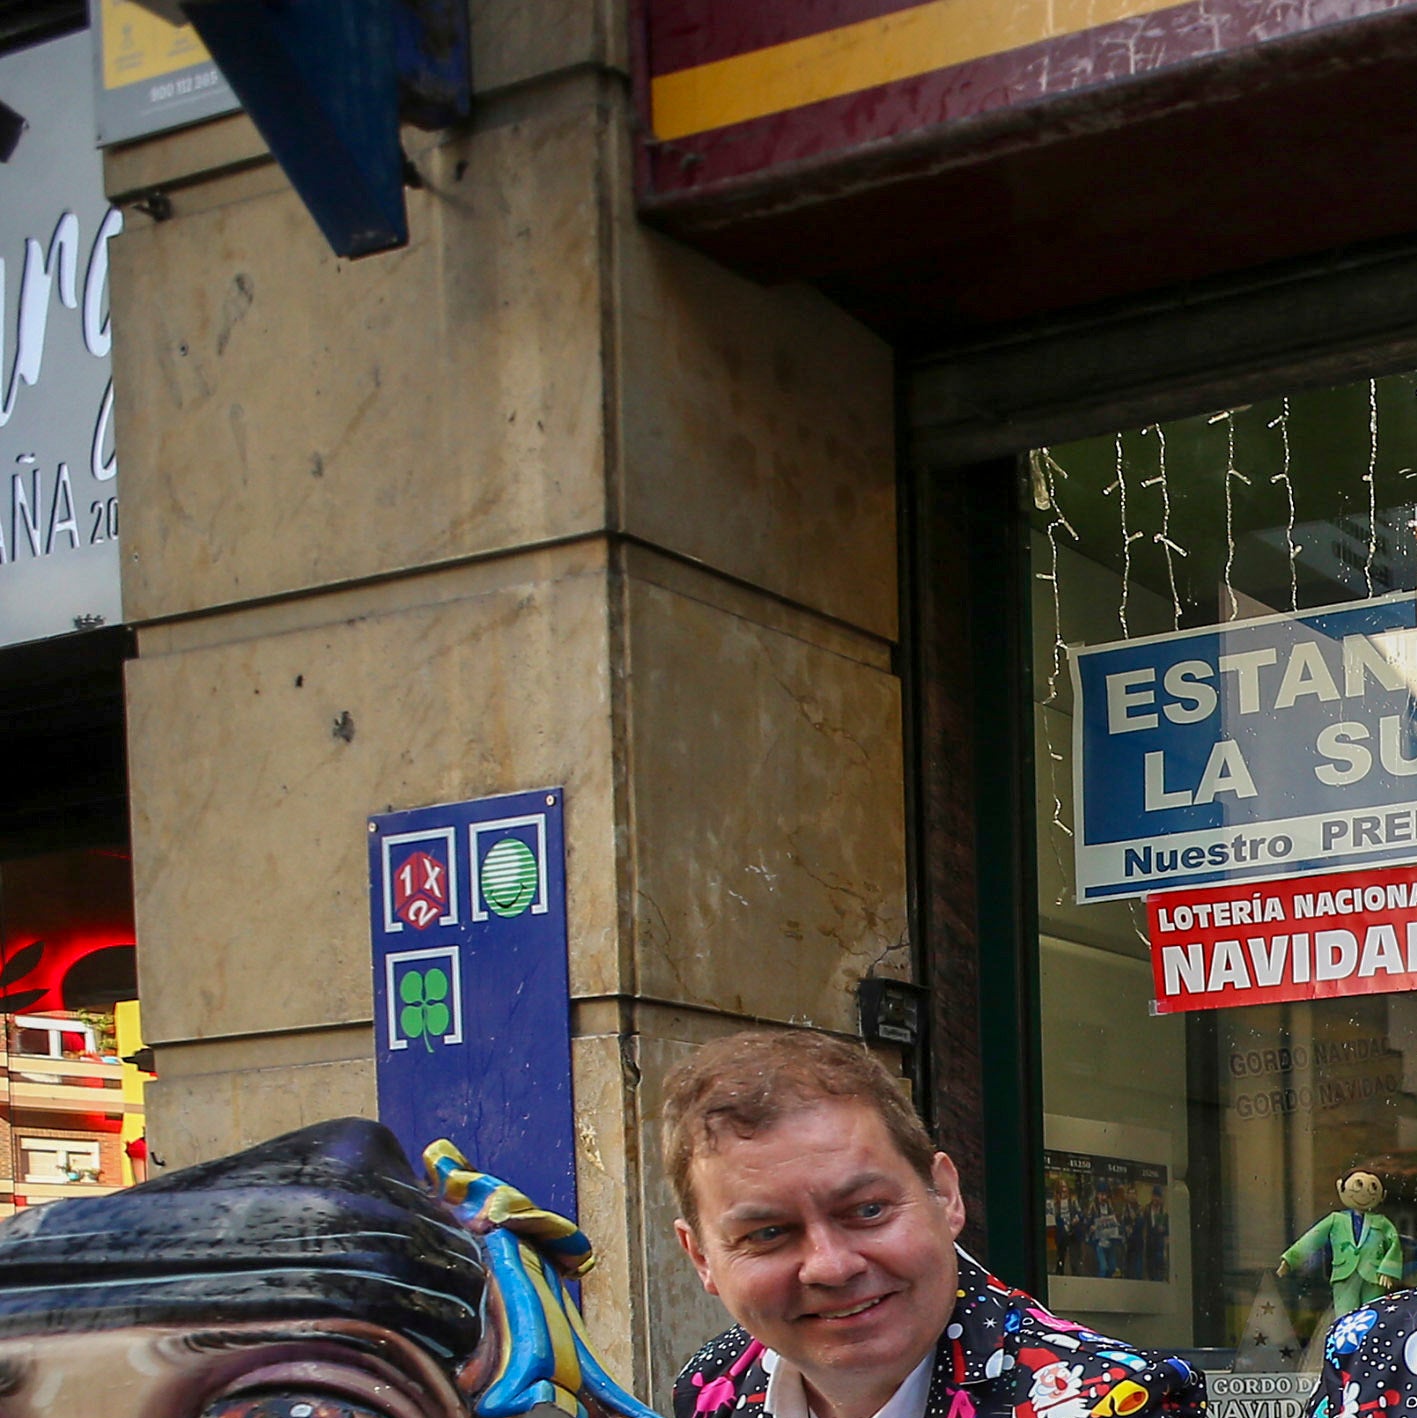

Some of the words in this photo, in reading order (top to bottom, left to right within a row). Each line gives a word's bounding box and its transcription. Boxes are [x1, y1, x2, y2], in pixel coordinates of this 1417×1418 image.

[0, 454, 80, 564] ÑA
[1142, 739, 1257, 813] LA
[1123, 830, 1294, 879] Nuestro
[1157, 891, 1286, 934] LOTERÍA
[1229, 1045, 1309, 1079] GORDO
[1235, 1085, 1313, 1120] GORDO
[1213, 1377, 1291, 1395] GORDO
